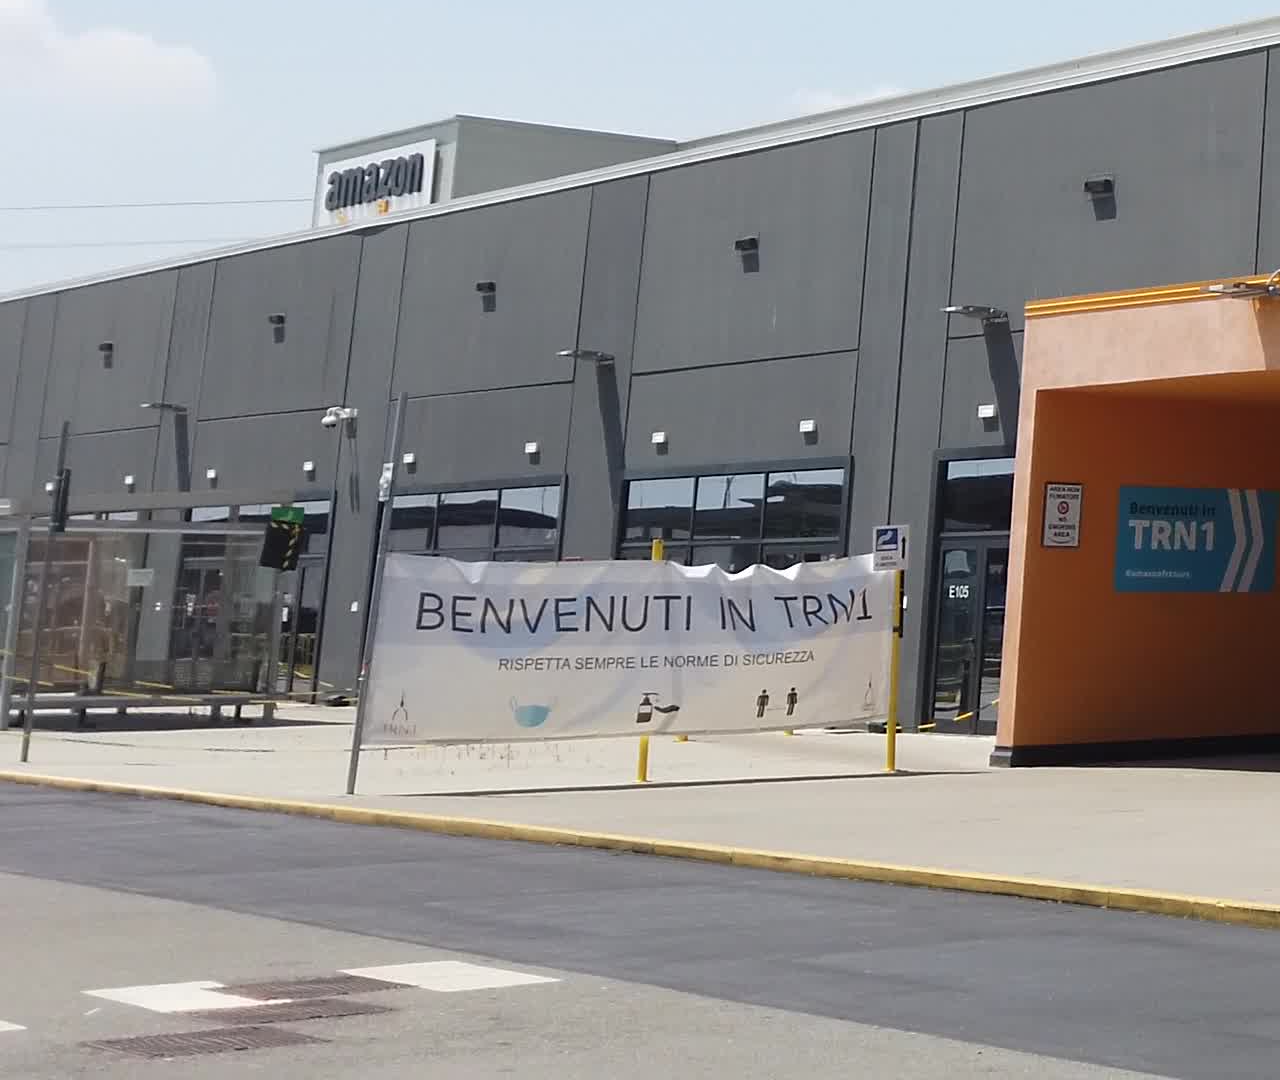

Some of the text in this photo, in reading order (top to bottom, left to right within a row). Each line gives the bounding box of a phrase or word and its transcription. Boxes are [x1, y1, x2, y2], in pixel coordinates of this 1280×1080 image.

[325, 153, 424, 211] amazon
[1128, 520, 1215, 551] TRN1
[948, 585, 969, 598] E105
[416, 588, 873, 634] BENVENUTI IN TRN1
[498, 650, 815, 671] RISPETTA SEMPRE LE NORME DI SICUREZZA
